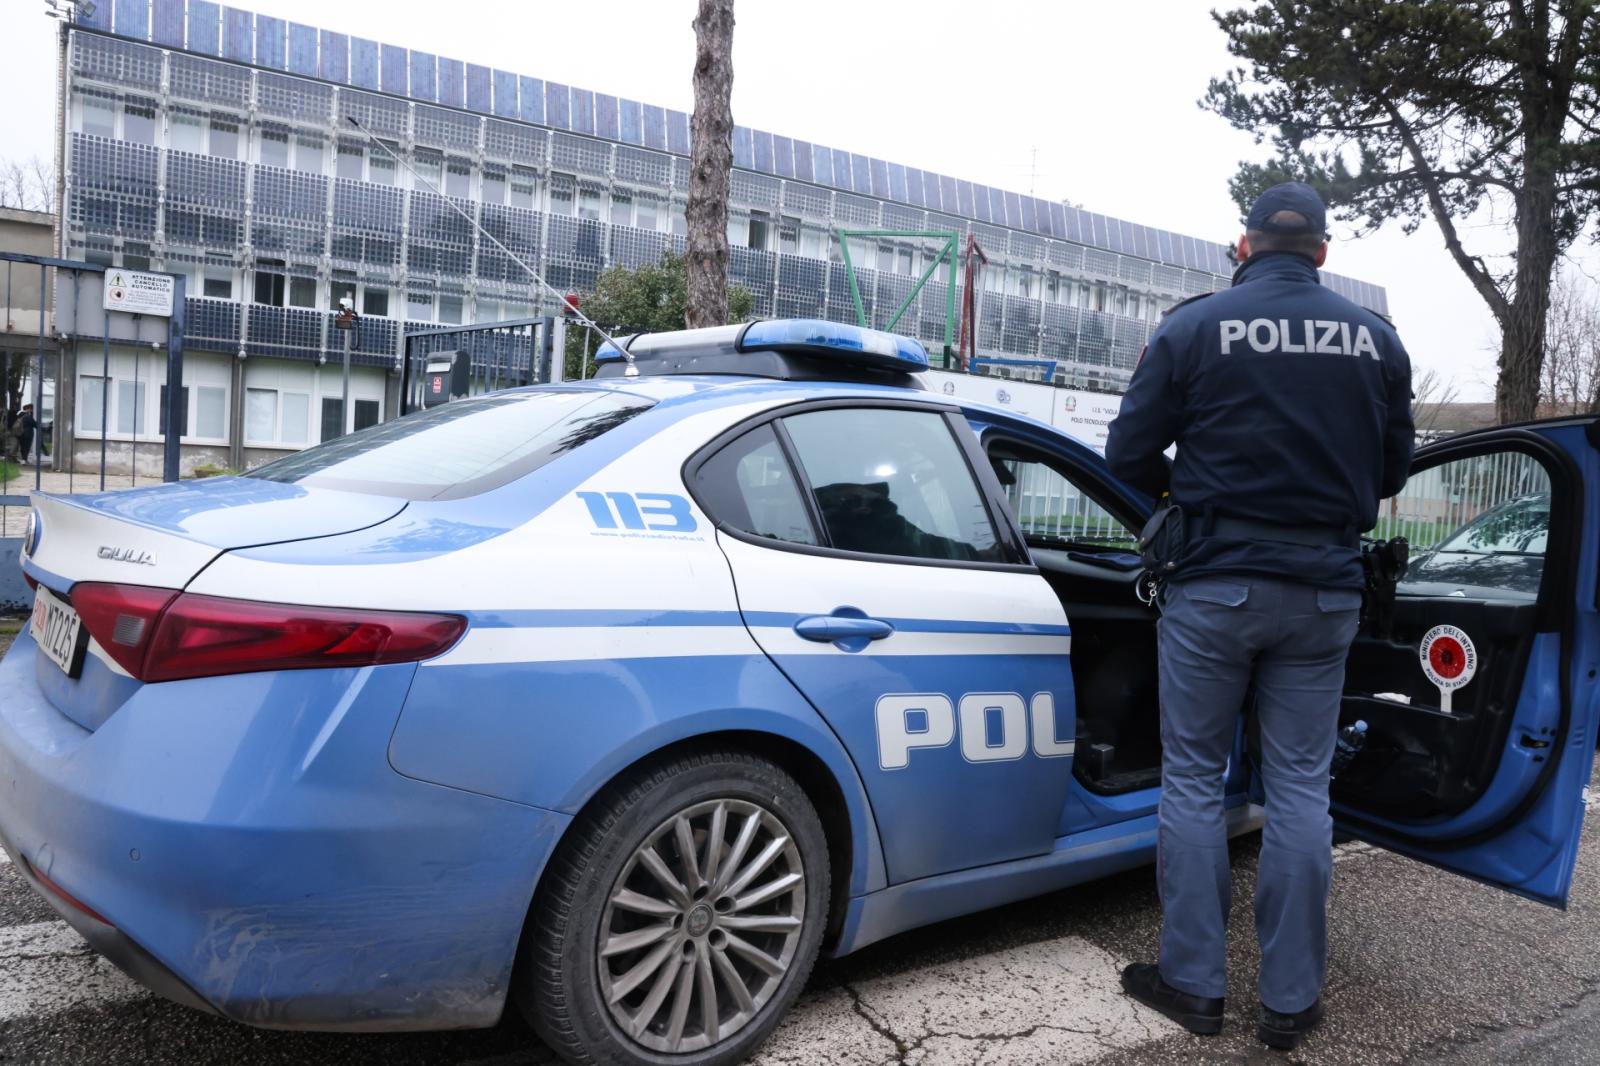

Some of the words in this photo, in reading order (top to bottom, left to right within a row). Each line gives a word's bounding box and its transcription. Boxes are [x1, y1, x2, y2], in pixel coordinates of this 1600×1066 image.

[132, 275, 170, 283] ATTENZIONE
[1219, 318, 1381, 361] POLIZIA
[575, 491, 698, 533] 113
[97, 546, 157, 566] GIULIA
[1421, 627, 1441, 660] MINISTERO
[1426, 668, 1444, 686] POLIZIA
[1452, 677, 1467, 688] STATO
[874, 691, 1075, 771] POL
